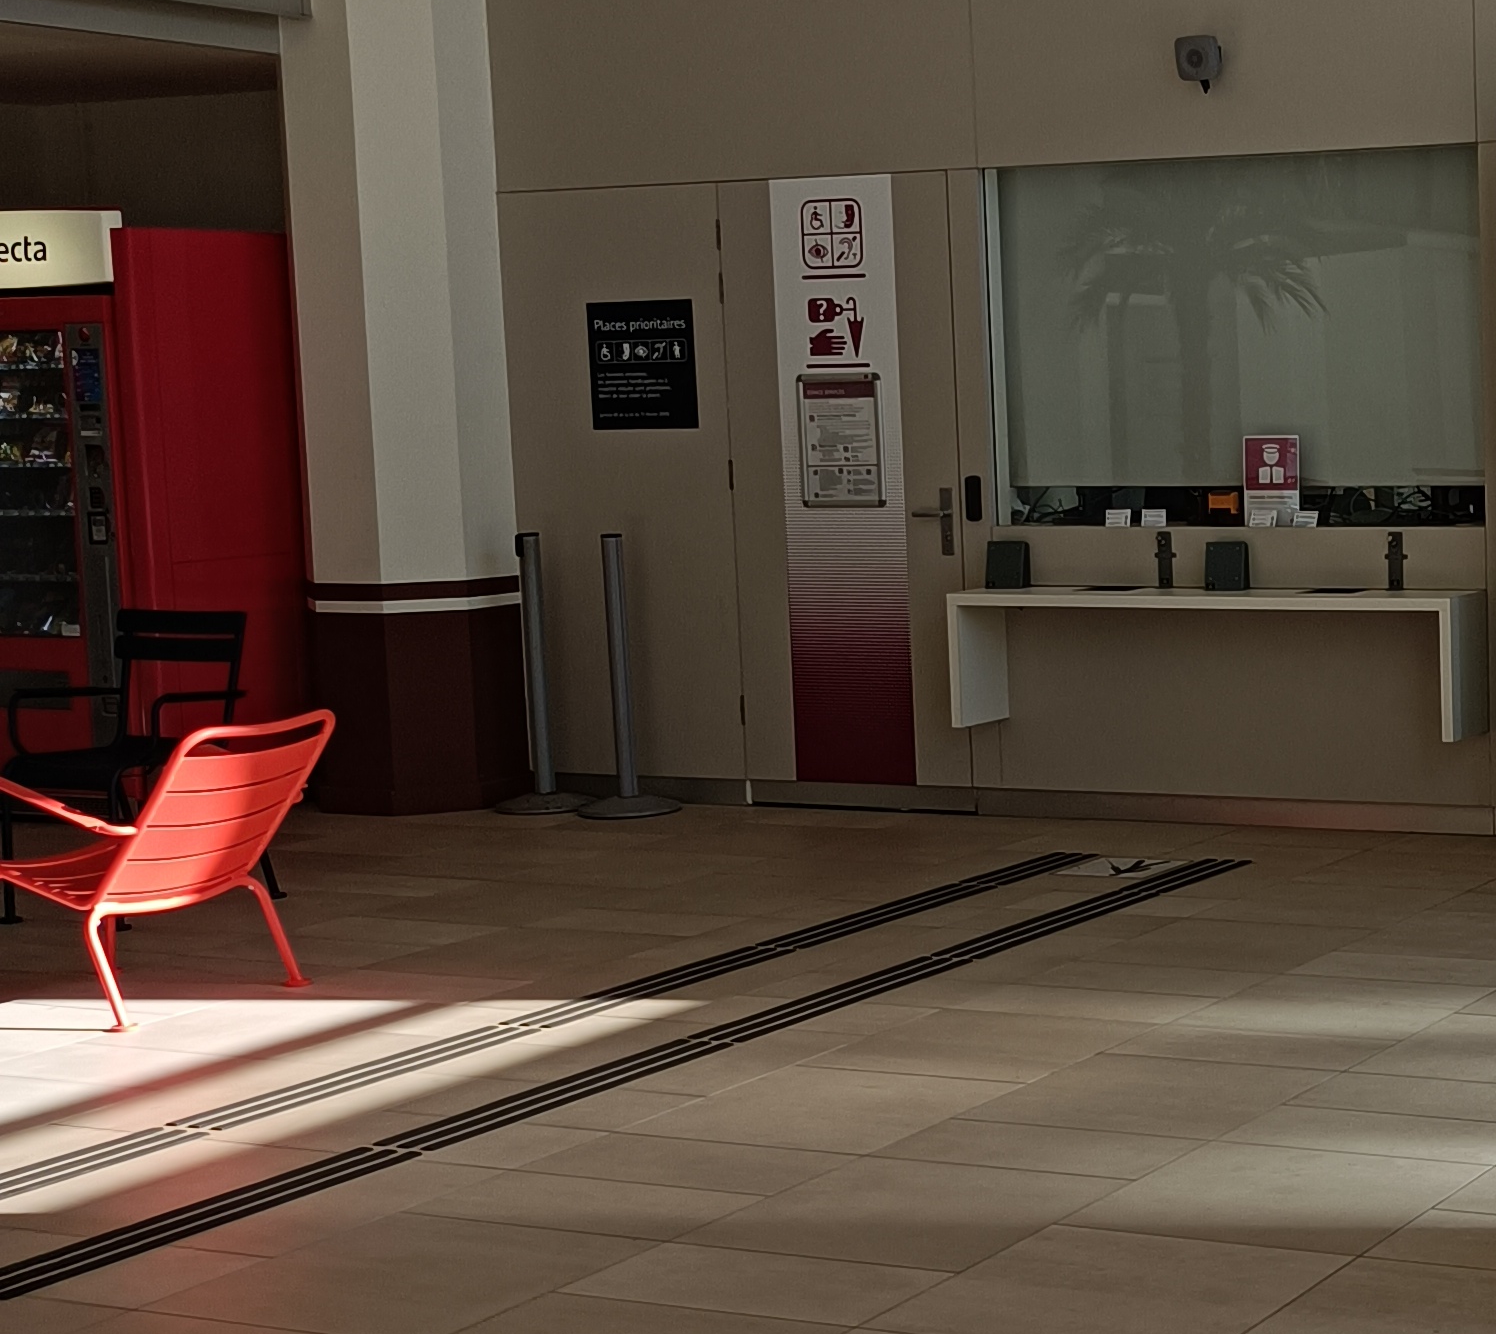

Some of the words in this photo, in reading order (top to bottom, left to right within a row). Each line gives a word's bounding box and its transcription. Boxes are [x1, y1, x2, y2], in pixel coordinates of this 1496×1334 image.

[0, 236, 47, 262] ecta
[594, 319, 627, 332] Places
[629, 317, 686, 333] prioritaires
